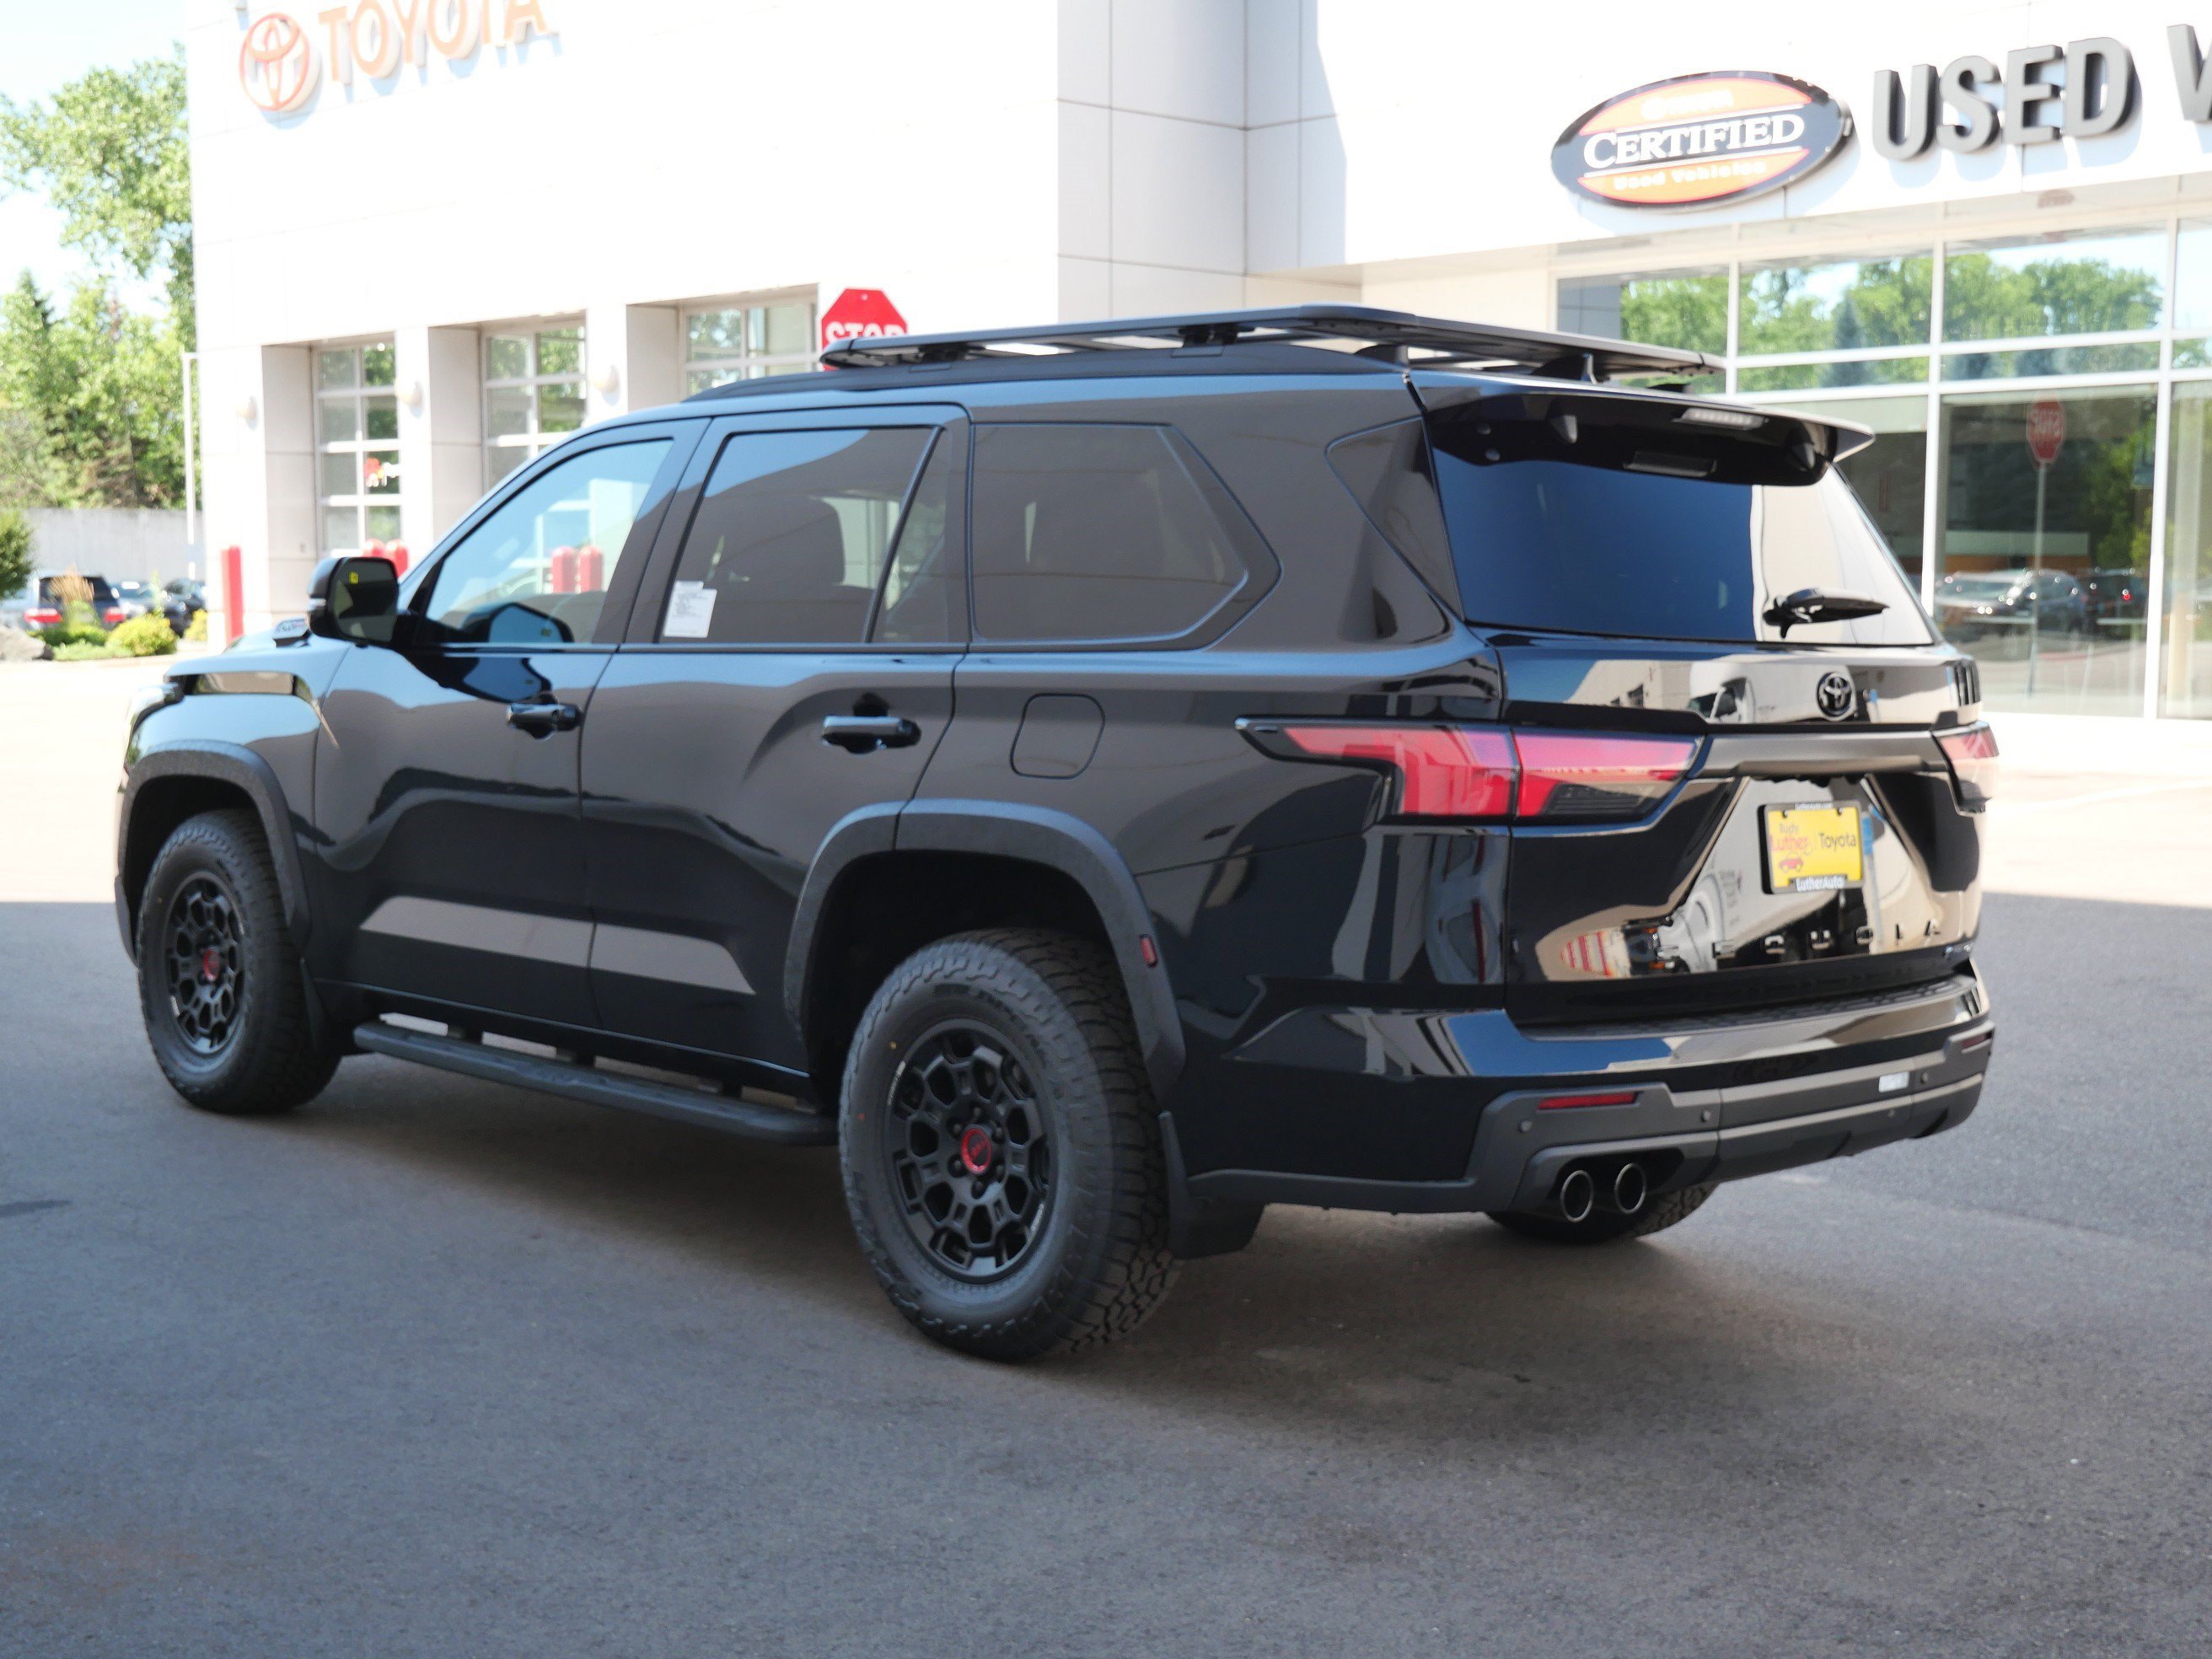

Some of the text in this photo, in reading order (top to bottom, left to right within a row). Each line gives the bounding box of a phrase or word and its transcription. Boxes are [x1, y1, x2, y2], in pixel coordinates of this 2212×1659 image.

[319, 0, 549, 82] TOYOTA
[1872, 37, 2135, 161] USED
[1583, 114, 1806, 169] CERTIFIED
[1613, 161, 1768, 191] Used Vehicles
[1818, 831, 1857, 852] Toyota
